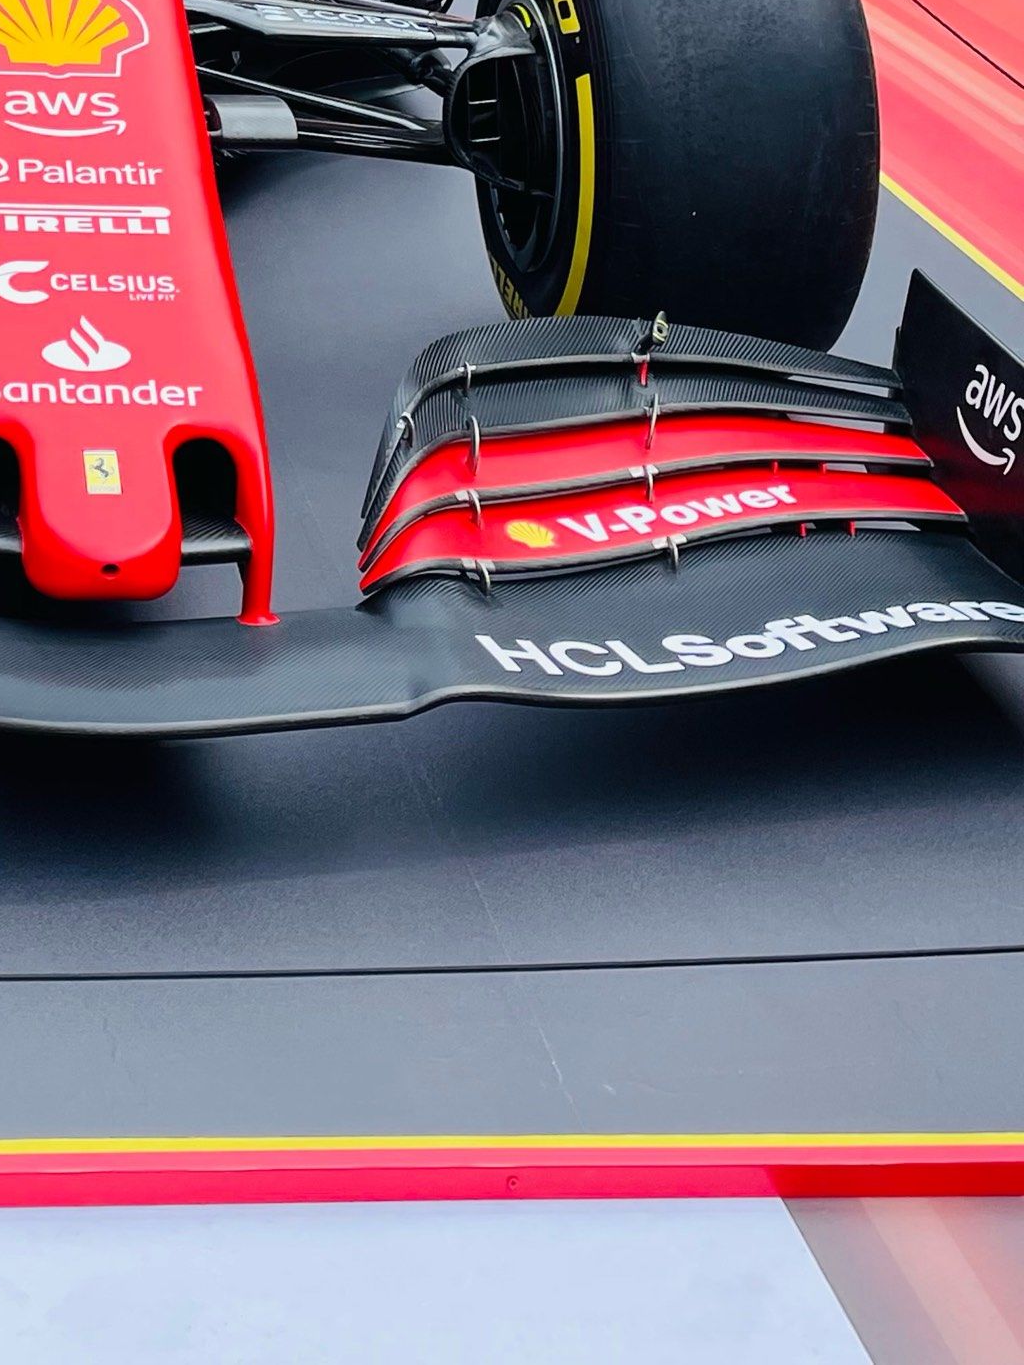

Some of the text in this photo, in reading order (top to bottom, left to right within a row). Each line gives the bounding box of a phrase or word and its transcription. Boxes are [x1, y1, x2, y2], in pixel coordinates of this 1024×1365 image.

[293, 8, 429, 31] ECOPOL
[4, 88, 120, 118] aws
[19, 159, 162, 186] Palantir
[50, 273, 176, 293] CELSIUS
[129, 293, 175, 301] LIVE FIT
[557, 481, 798, 544] V-Power
[474, 600, 1024, 678] HCLSoftware
